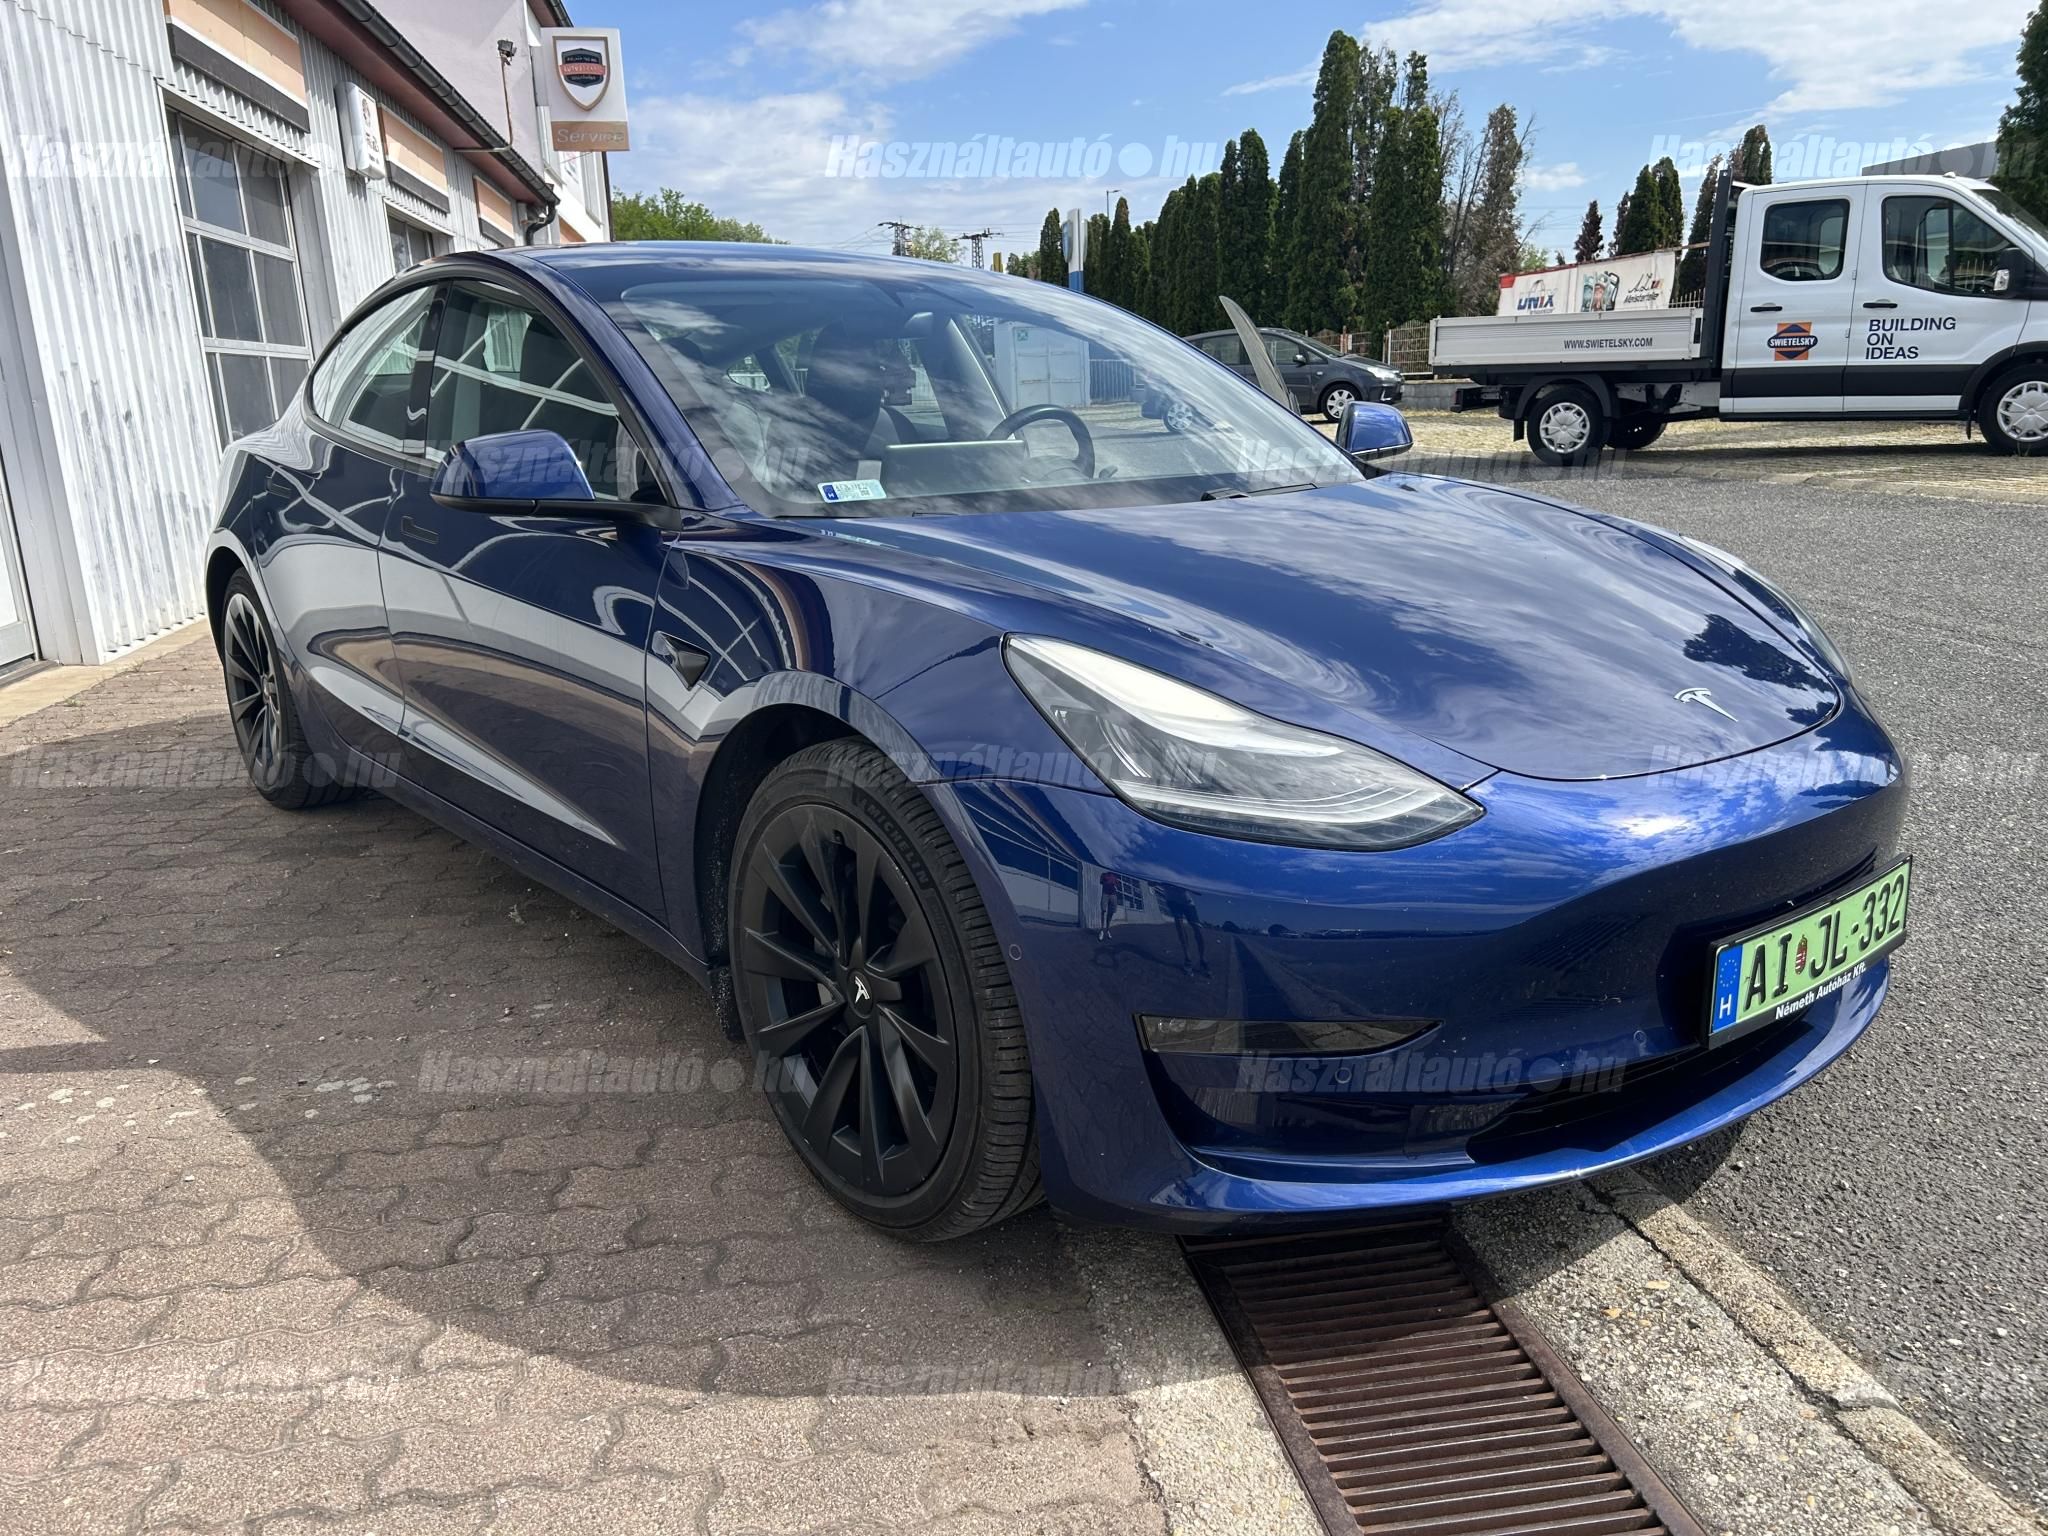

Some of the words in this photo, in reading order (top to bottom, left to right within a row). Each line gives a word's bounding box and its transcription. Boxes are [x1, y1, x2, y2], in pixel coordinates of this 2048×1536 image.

[557, 128, 625, 143] Service
[1517, 294, 1555, 310] UNIX
[1868, 316, 1957, 332] BUILDING
[1564, 337, 1653, 350] WWW.SWIETELSKY.COM
[1768, 336, 1816, 347] SWIETELSKY
[1866, 332, 1894, 346] ON
[1865, 346, 1920, 360] IDEAS
[867, 803, 929, 884] MICHELIN
[1775, 992, 1815, 1020] Németh
[1816, 970, 1852, 1000] Autóház
[1852, 962, 1867, 978] Kft.
[1719, 993, 1733, 1019] H
